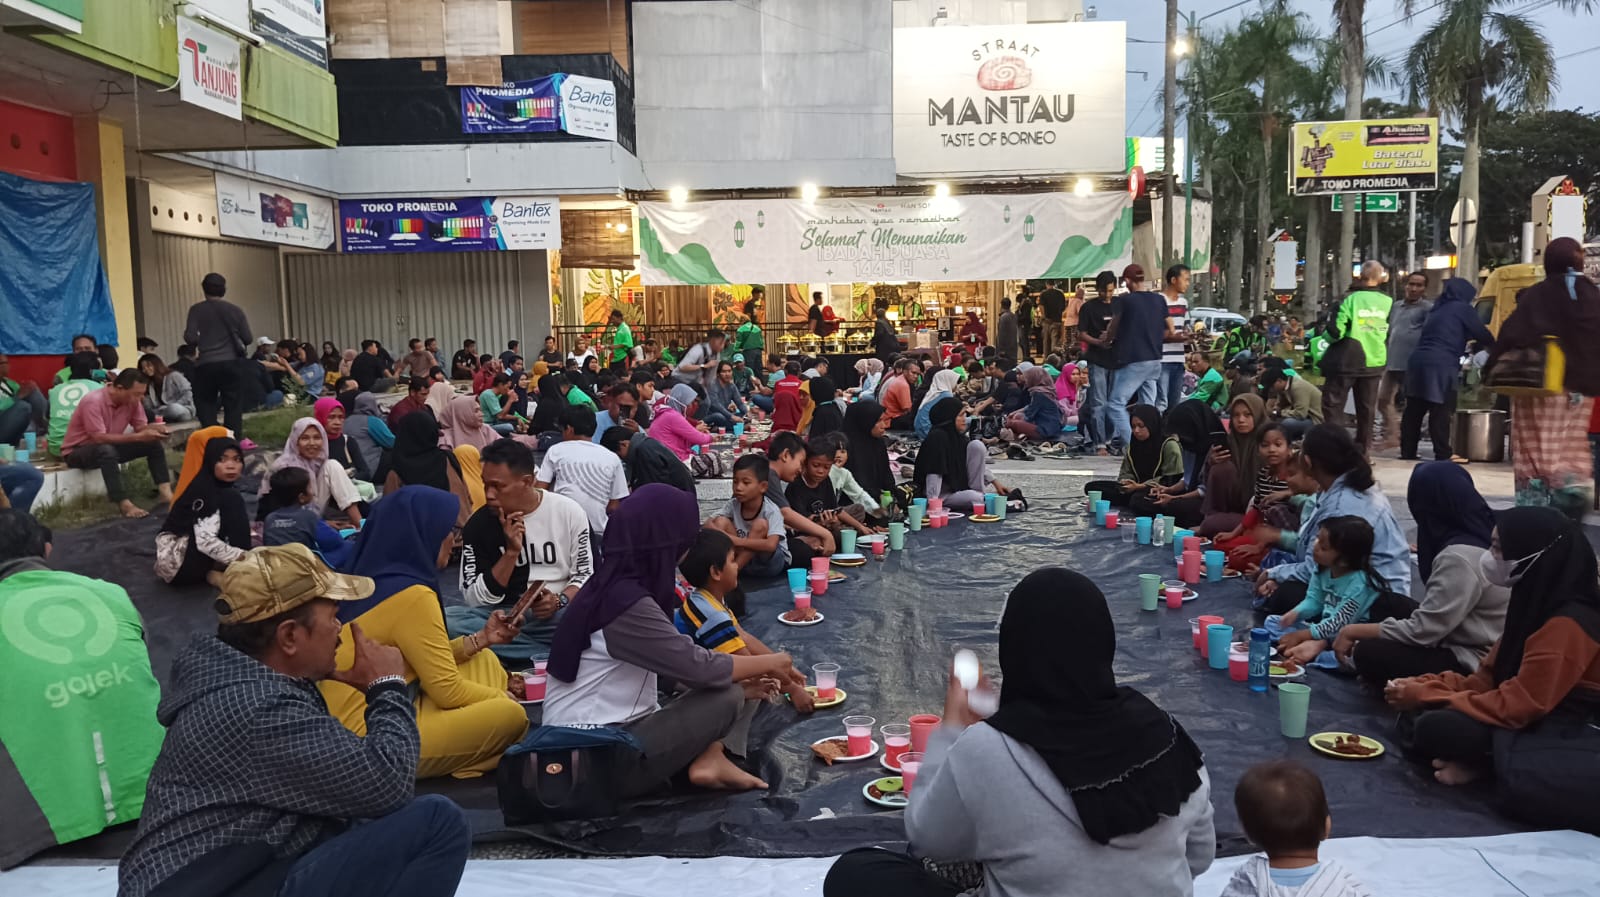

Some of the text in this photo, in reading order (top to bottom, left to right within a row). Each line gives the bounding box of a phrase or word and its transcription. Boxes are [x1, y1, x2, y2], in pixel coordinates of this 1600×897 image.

[972, 39, 1040, 61] STRAAT
[475, 87, 534, 97] PROMEDIA
[928, 94, 1075, 126] MANTAU
[941, 131, 1056, 147] TASTE OF BORNEO
[1362, 160, 1391, 169] Luar
[1321, 177, 1409, 189] TOKO PROMEDIA
[361, 202, 458, 213] TOKO PROMEDIA
[503, 202, 552, 218] Bantex
[800, 227, 967, 250] Selamat Menunaikan
[817, 244, 950, 262] IBADAH PUASA
[853, 259, 914, 277] 1445 H
[44, 661, 134, 708] gojek
